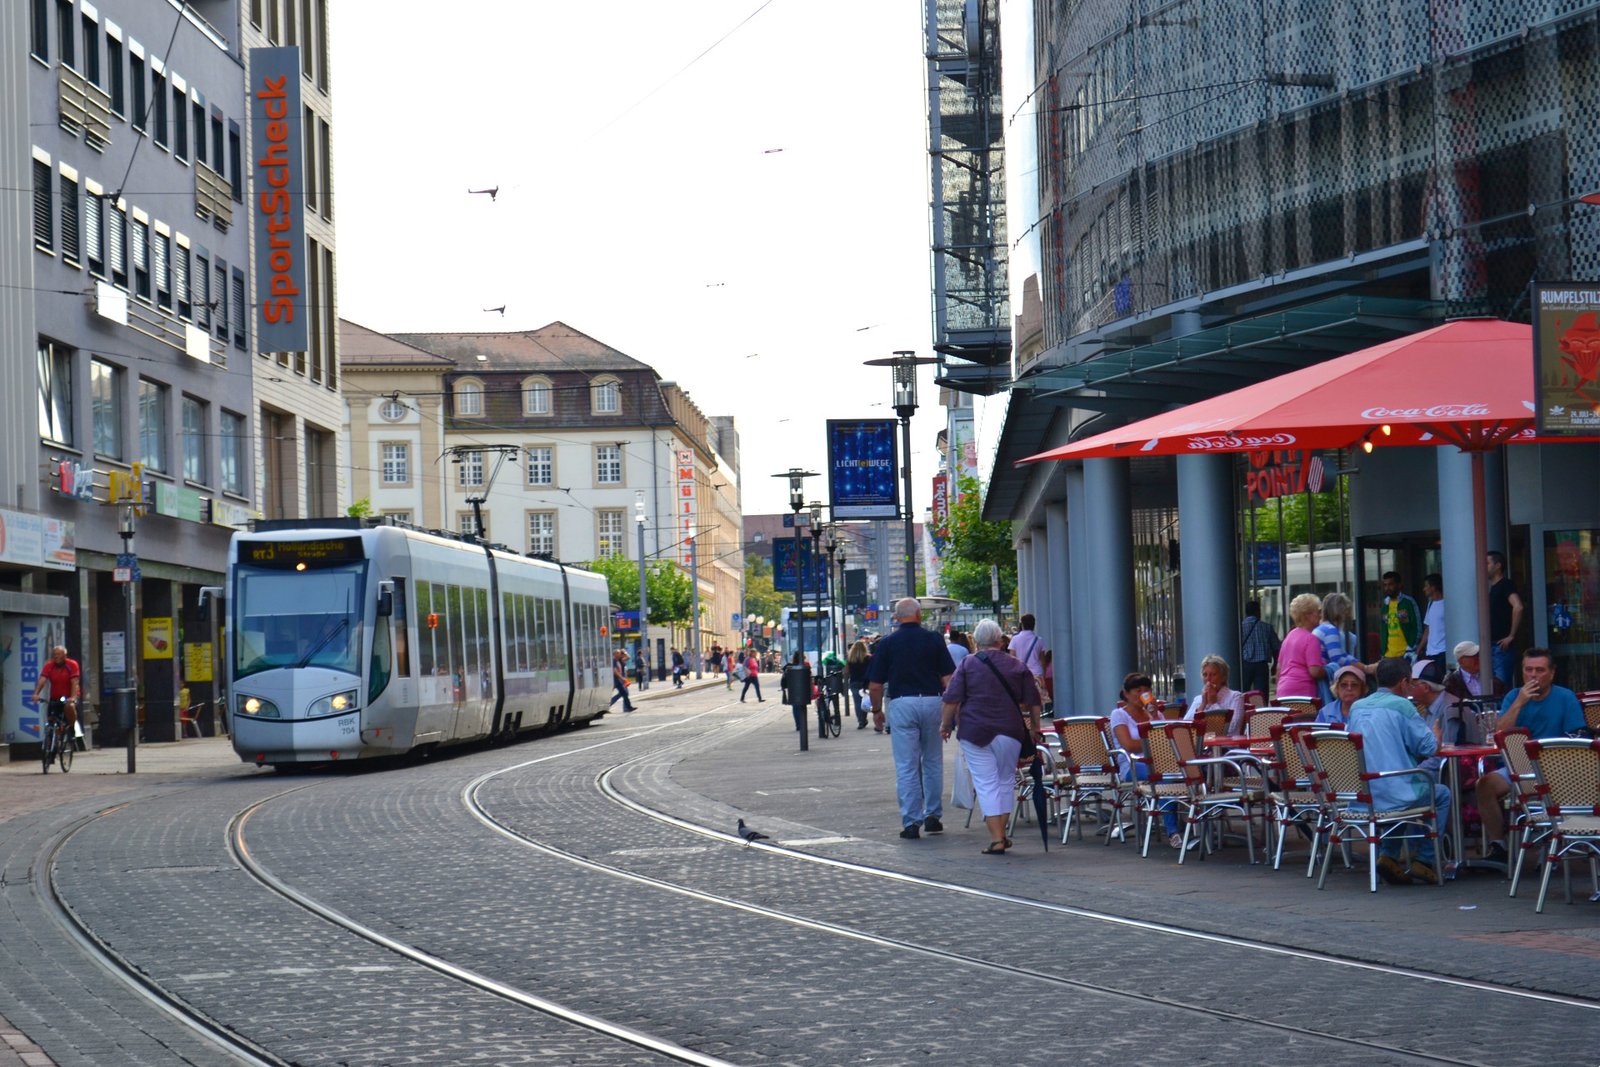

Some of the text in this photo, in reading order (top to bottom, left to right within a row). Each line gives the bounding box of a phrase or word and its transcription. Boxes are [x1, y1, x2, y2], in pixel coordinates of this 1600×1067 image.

[257, 74, 299, 324] SportScheck
[1361, 403, 1490, 420] Coca-Cola
[1247, 466, 1297, 501] POINT
[337, 718, 355, 727] RBK
[341, 727, 355, 735] 704
